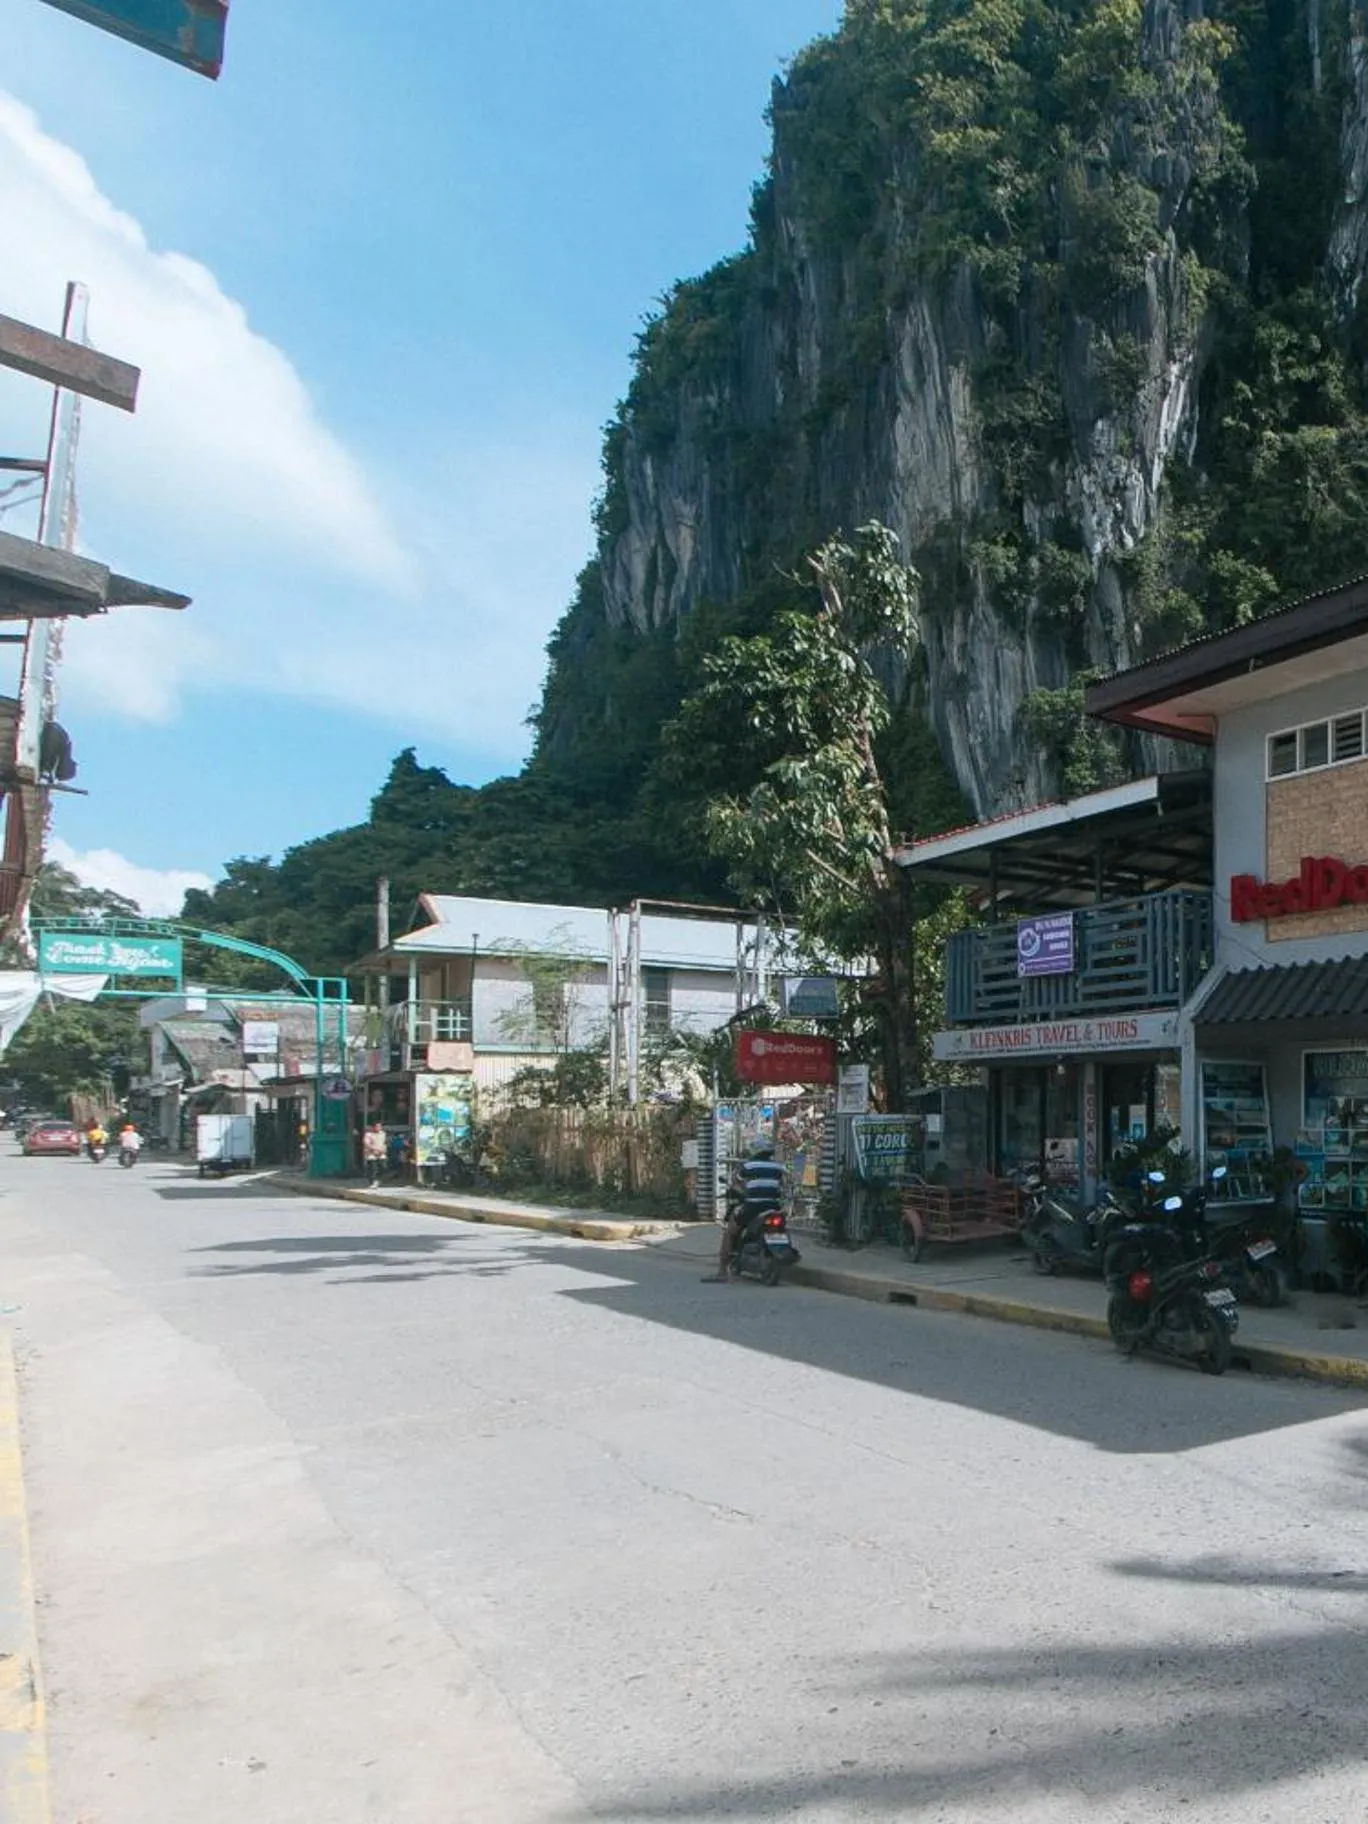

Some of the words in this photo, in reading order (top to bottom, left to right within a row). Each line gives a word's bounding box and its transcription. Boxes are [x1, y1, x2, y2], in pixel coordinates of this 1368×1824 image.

[1036, 1022, 1081, 1045] TRAVEL
[1084, 1022, 1093, 1040] &
[1098, 1018, 1138, 1039] TOURS
